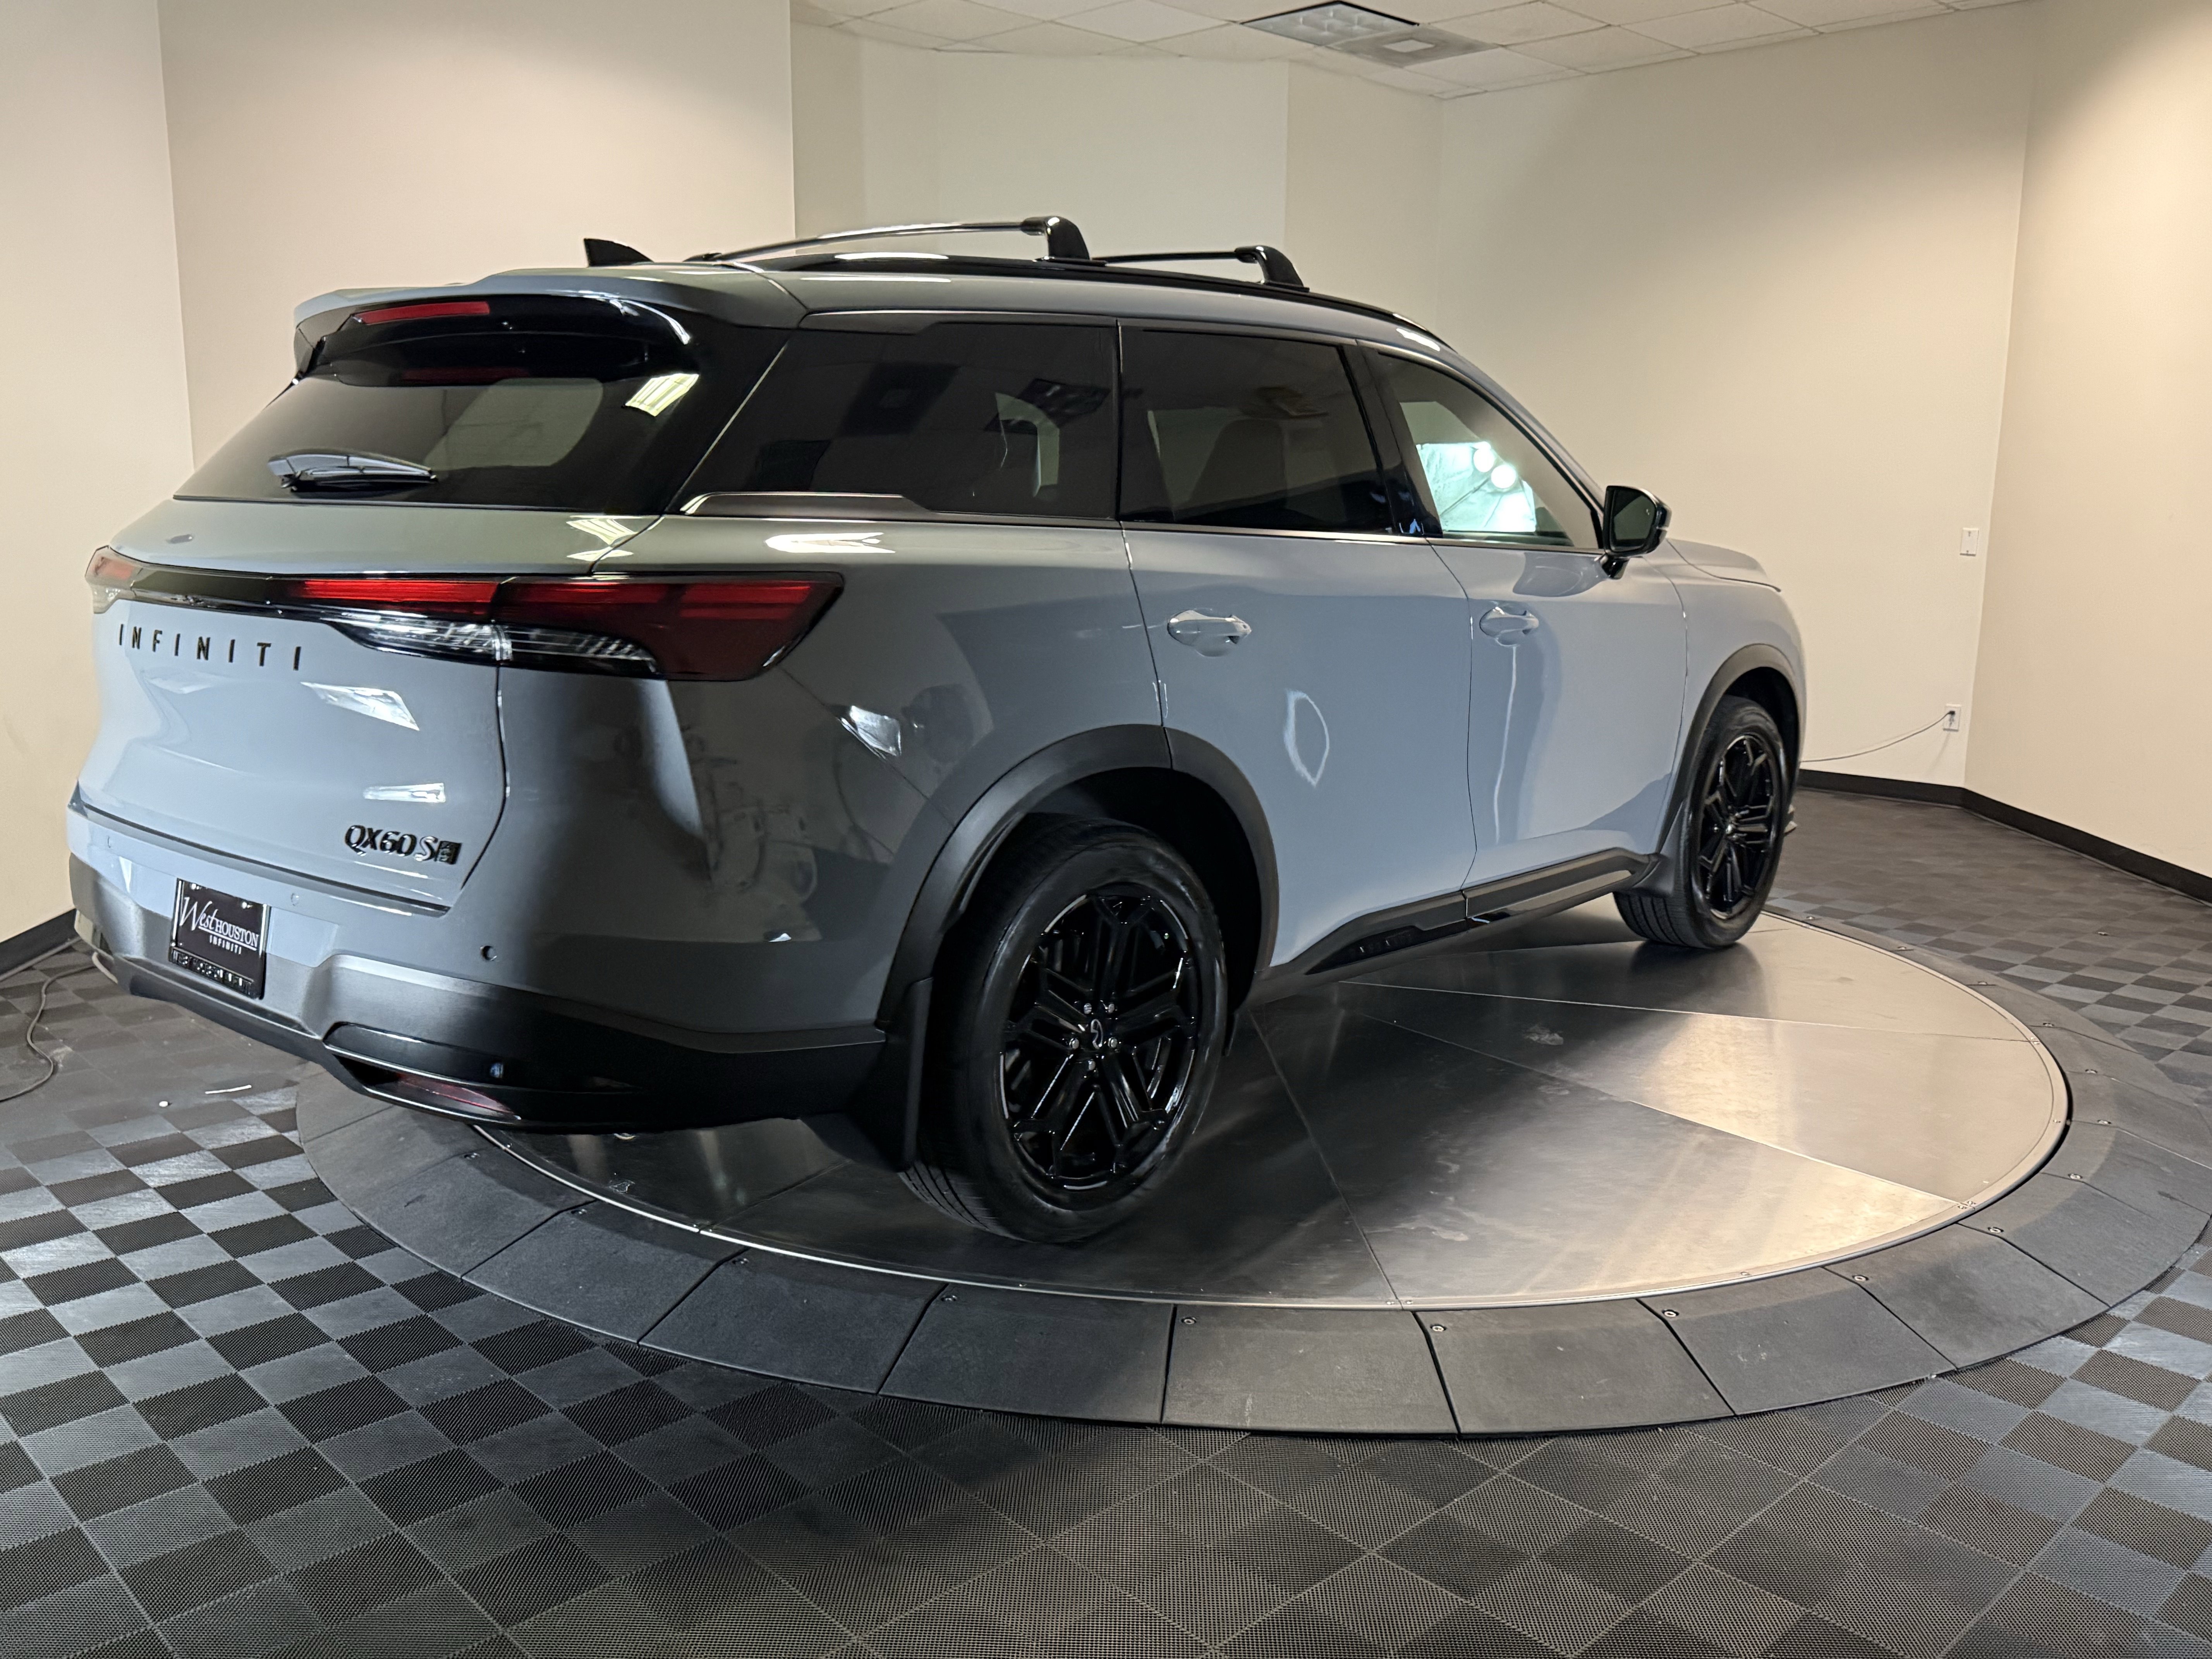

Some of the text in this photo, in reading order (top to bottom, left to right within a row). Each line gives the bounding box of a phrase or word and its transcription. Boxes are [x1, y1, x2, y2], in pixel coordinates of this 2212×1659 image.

[119, 623, 301, 671] INFINITI
[345, 825, 417, 856] QX60
[210, 935, 242, 955] INFINITI
